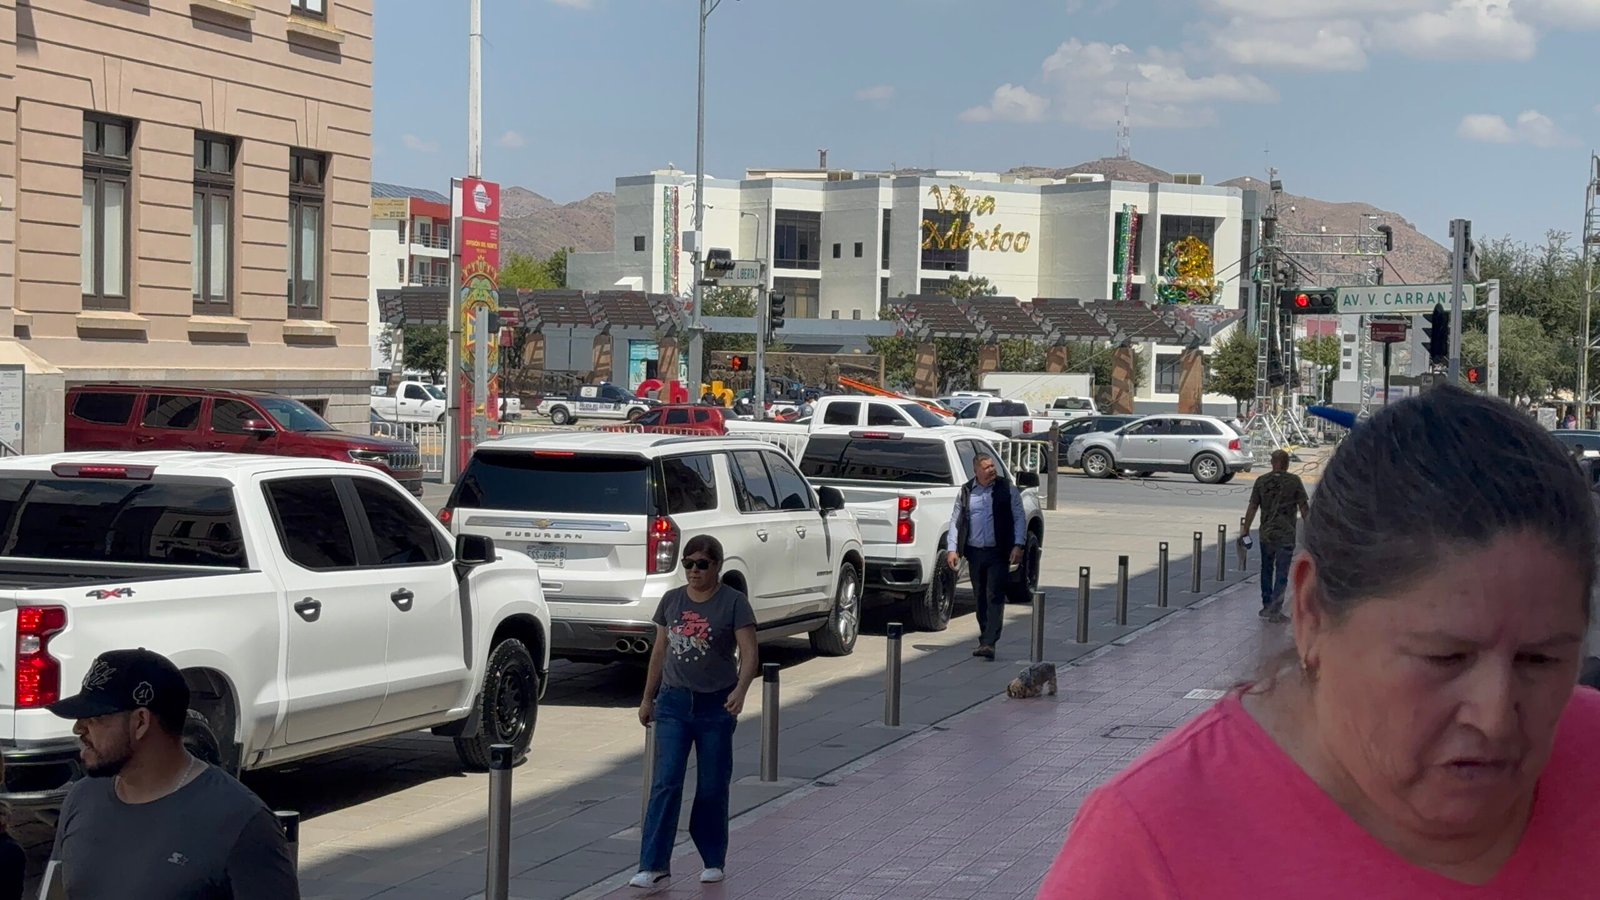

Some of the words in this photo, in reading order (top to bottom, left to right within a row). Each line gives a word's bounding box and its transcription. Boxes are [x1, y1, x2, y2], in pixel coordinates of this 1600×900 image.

[737, 268, 759, 280] LIBERTAD
[1343, 294, 1362, 306] AV.
[1368, 293, 1378, 306] V.
[505, 531, 583, 539] SUBURBAN
